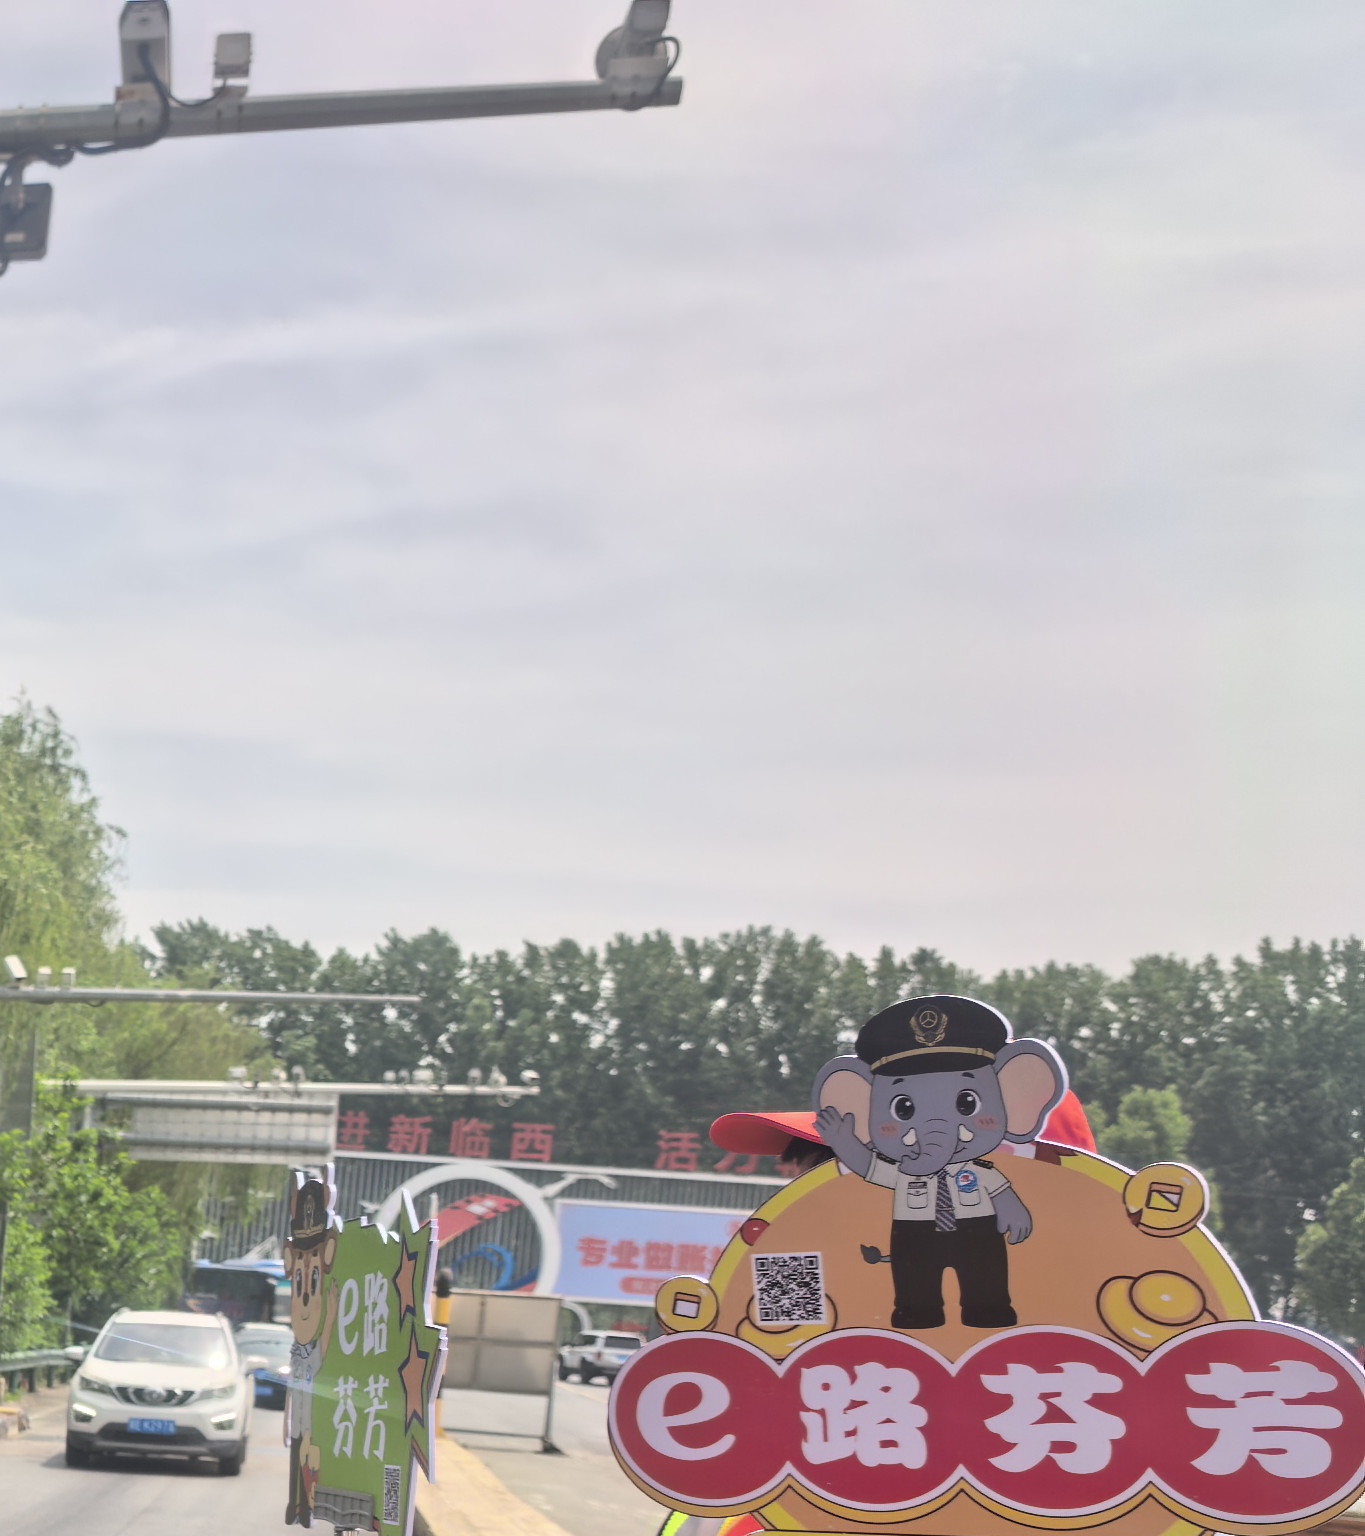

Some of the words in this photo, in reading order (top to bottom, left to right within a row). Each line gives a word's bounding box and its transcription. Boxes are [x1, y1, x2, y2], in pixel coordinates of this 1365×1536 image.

[337, 1270, 390, 1357] e路
[332, 1373, 390, 1463] 芬芳
[635, 1358, 1344, 1478] e路芬芳
